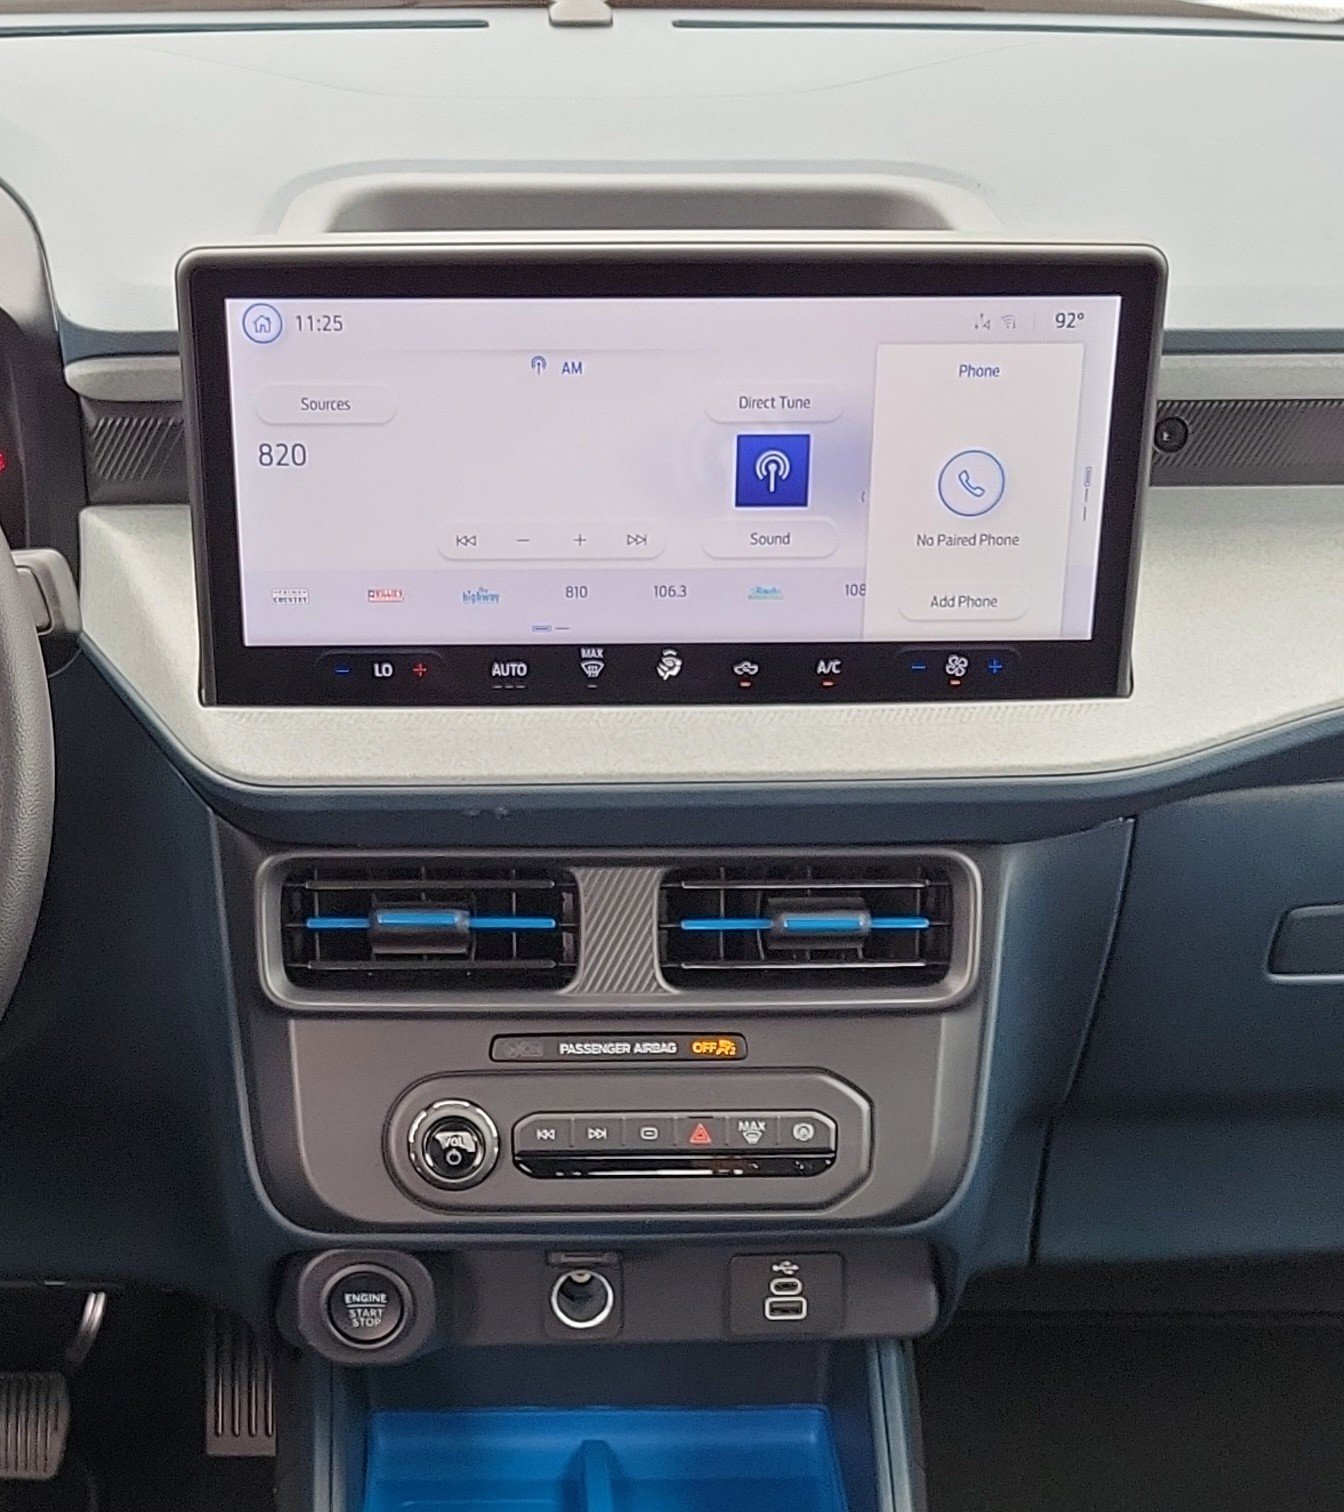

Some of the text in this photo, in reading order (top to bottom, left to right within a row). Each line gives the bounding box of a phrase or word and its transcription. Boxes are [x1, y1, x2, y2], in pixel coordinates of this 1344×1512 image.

[296, 315, 344, 333] 11:25
[1055, 312, 1085, 329] 92°
[561, 362, 583, 376] AM
[958, 364, 1000, 380] Phone
[300, 397, 351, 413] Sources
[738, 396, 811, 411] Direct Tune
[258, 444, 307, 468] 820
[750, 532, 791, 547] Sound
[916, 533, 1020, 548] No Paired Phone
[565, 585, 588, 598] 810
[653, 585, 688, 598] 106.3
[930, 594, 998, 610] Add Phone
[581, 648, 604, 659] MAX
[373, 662, 393, 678] LO
[492, 663, 528, 679] AUTO
[817, 660, 841, 674] A/C
[559, 1041, 718, 1055] PASSENGER AIRBAG OFF
[738, 1120, 766, 1132] MAX
[344, 1292, 388, 1304] ENGINE
[348, 1308, 383, 1318] START
[352, 1318, 382, 1328] STOP
